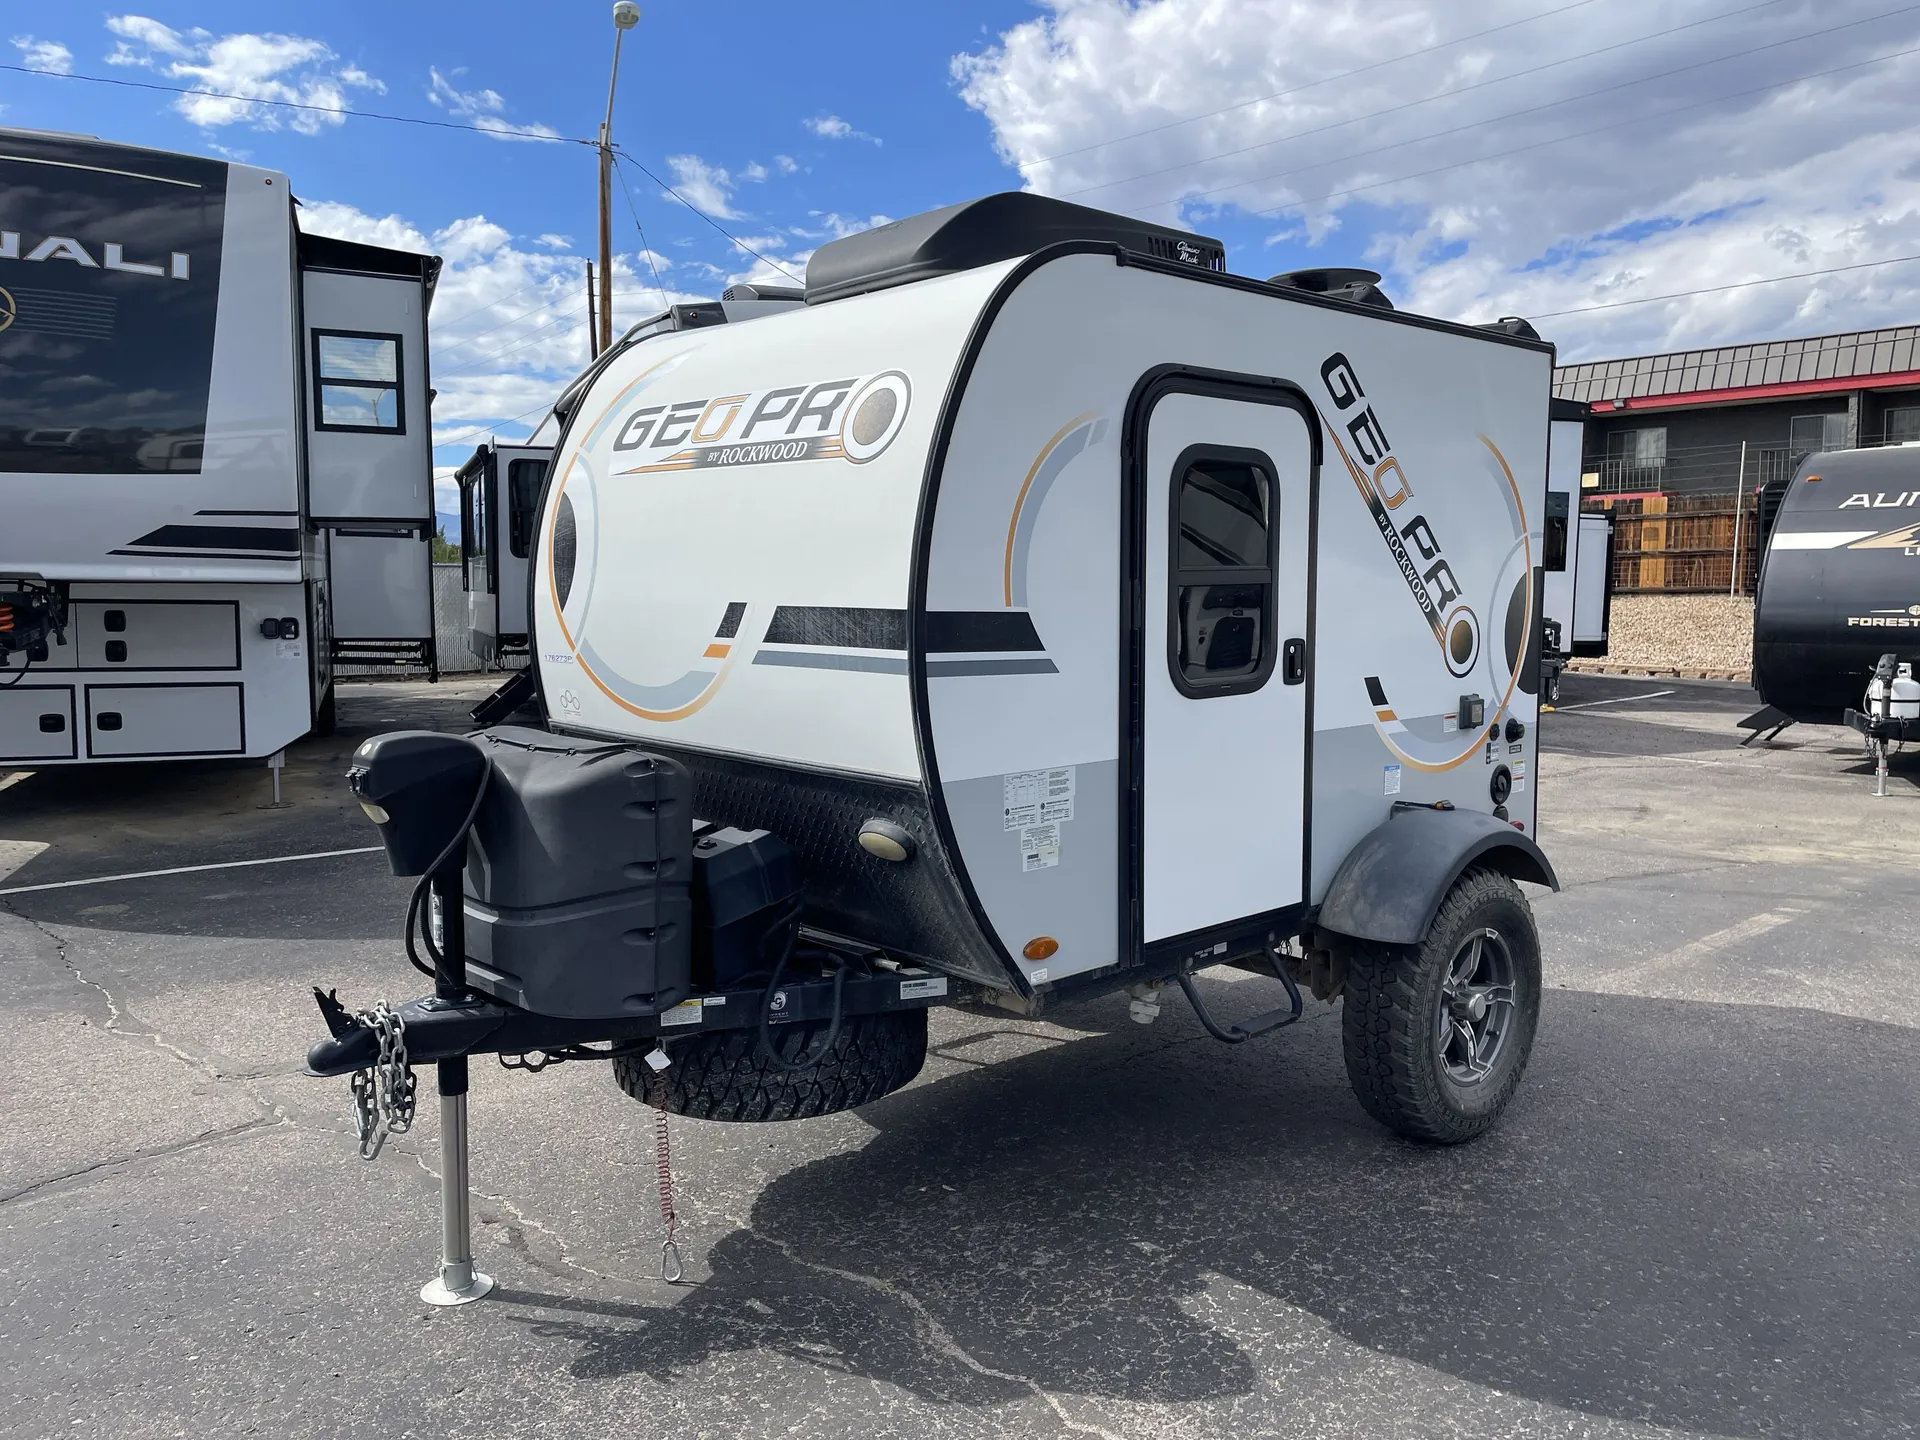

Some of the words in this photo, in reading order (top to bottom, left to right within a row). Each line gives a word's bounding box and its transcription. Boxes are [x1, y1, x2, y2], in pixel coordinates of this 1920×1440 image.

[612, 392, 752, 452] GEO
[706, 451, 719, 463] BY
[717, 440, 810, 465] ROCKWOOD
[1320, 351, 1415, 511] GEO
[1383, 524, 1433, 613] ROCKWOOD
